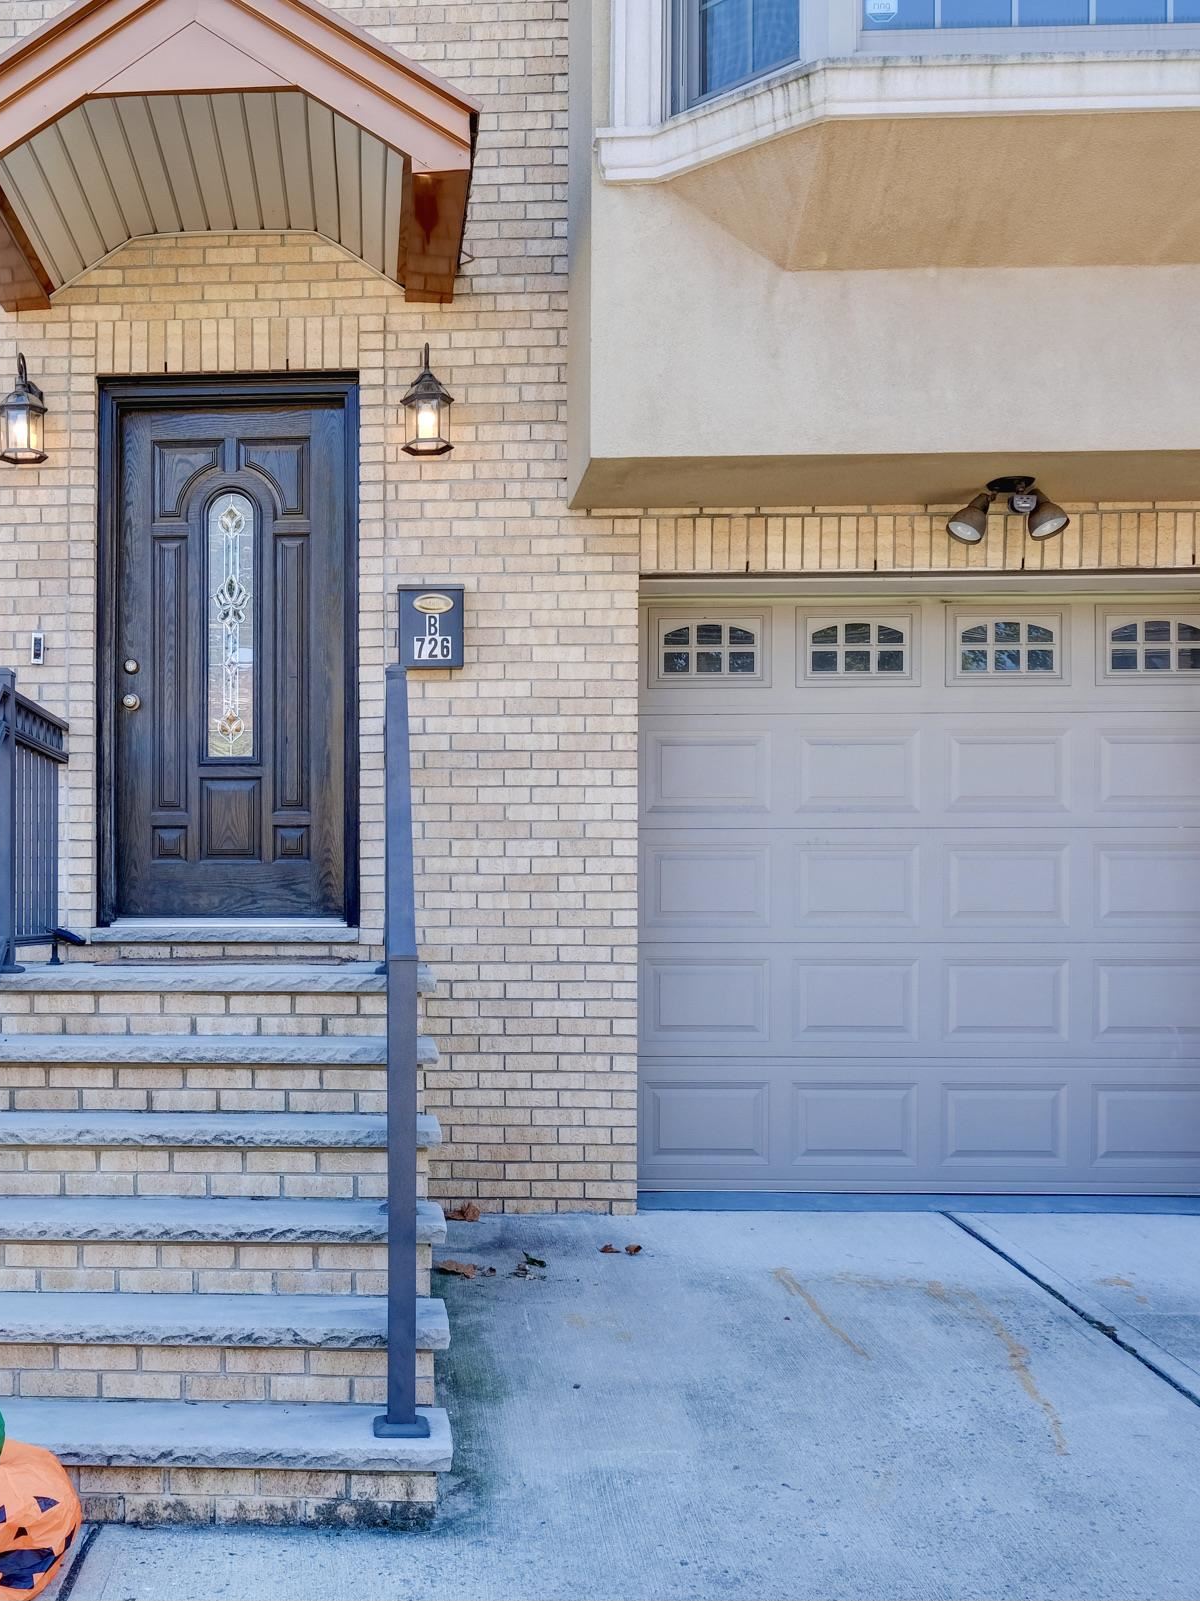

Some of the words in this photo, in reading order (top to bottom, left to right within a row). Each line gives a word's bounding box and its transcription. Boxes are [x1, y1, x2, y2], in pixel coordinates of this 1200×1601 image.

[873, 2, 891, 11] ring
[428, 615, 438, 636] B
[415, 637, 450, 658] 726
